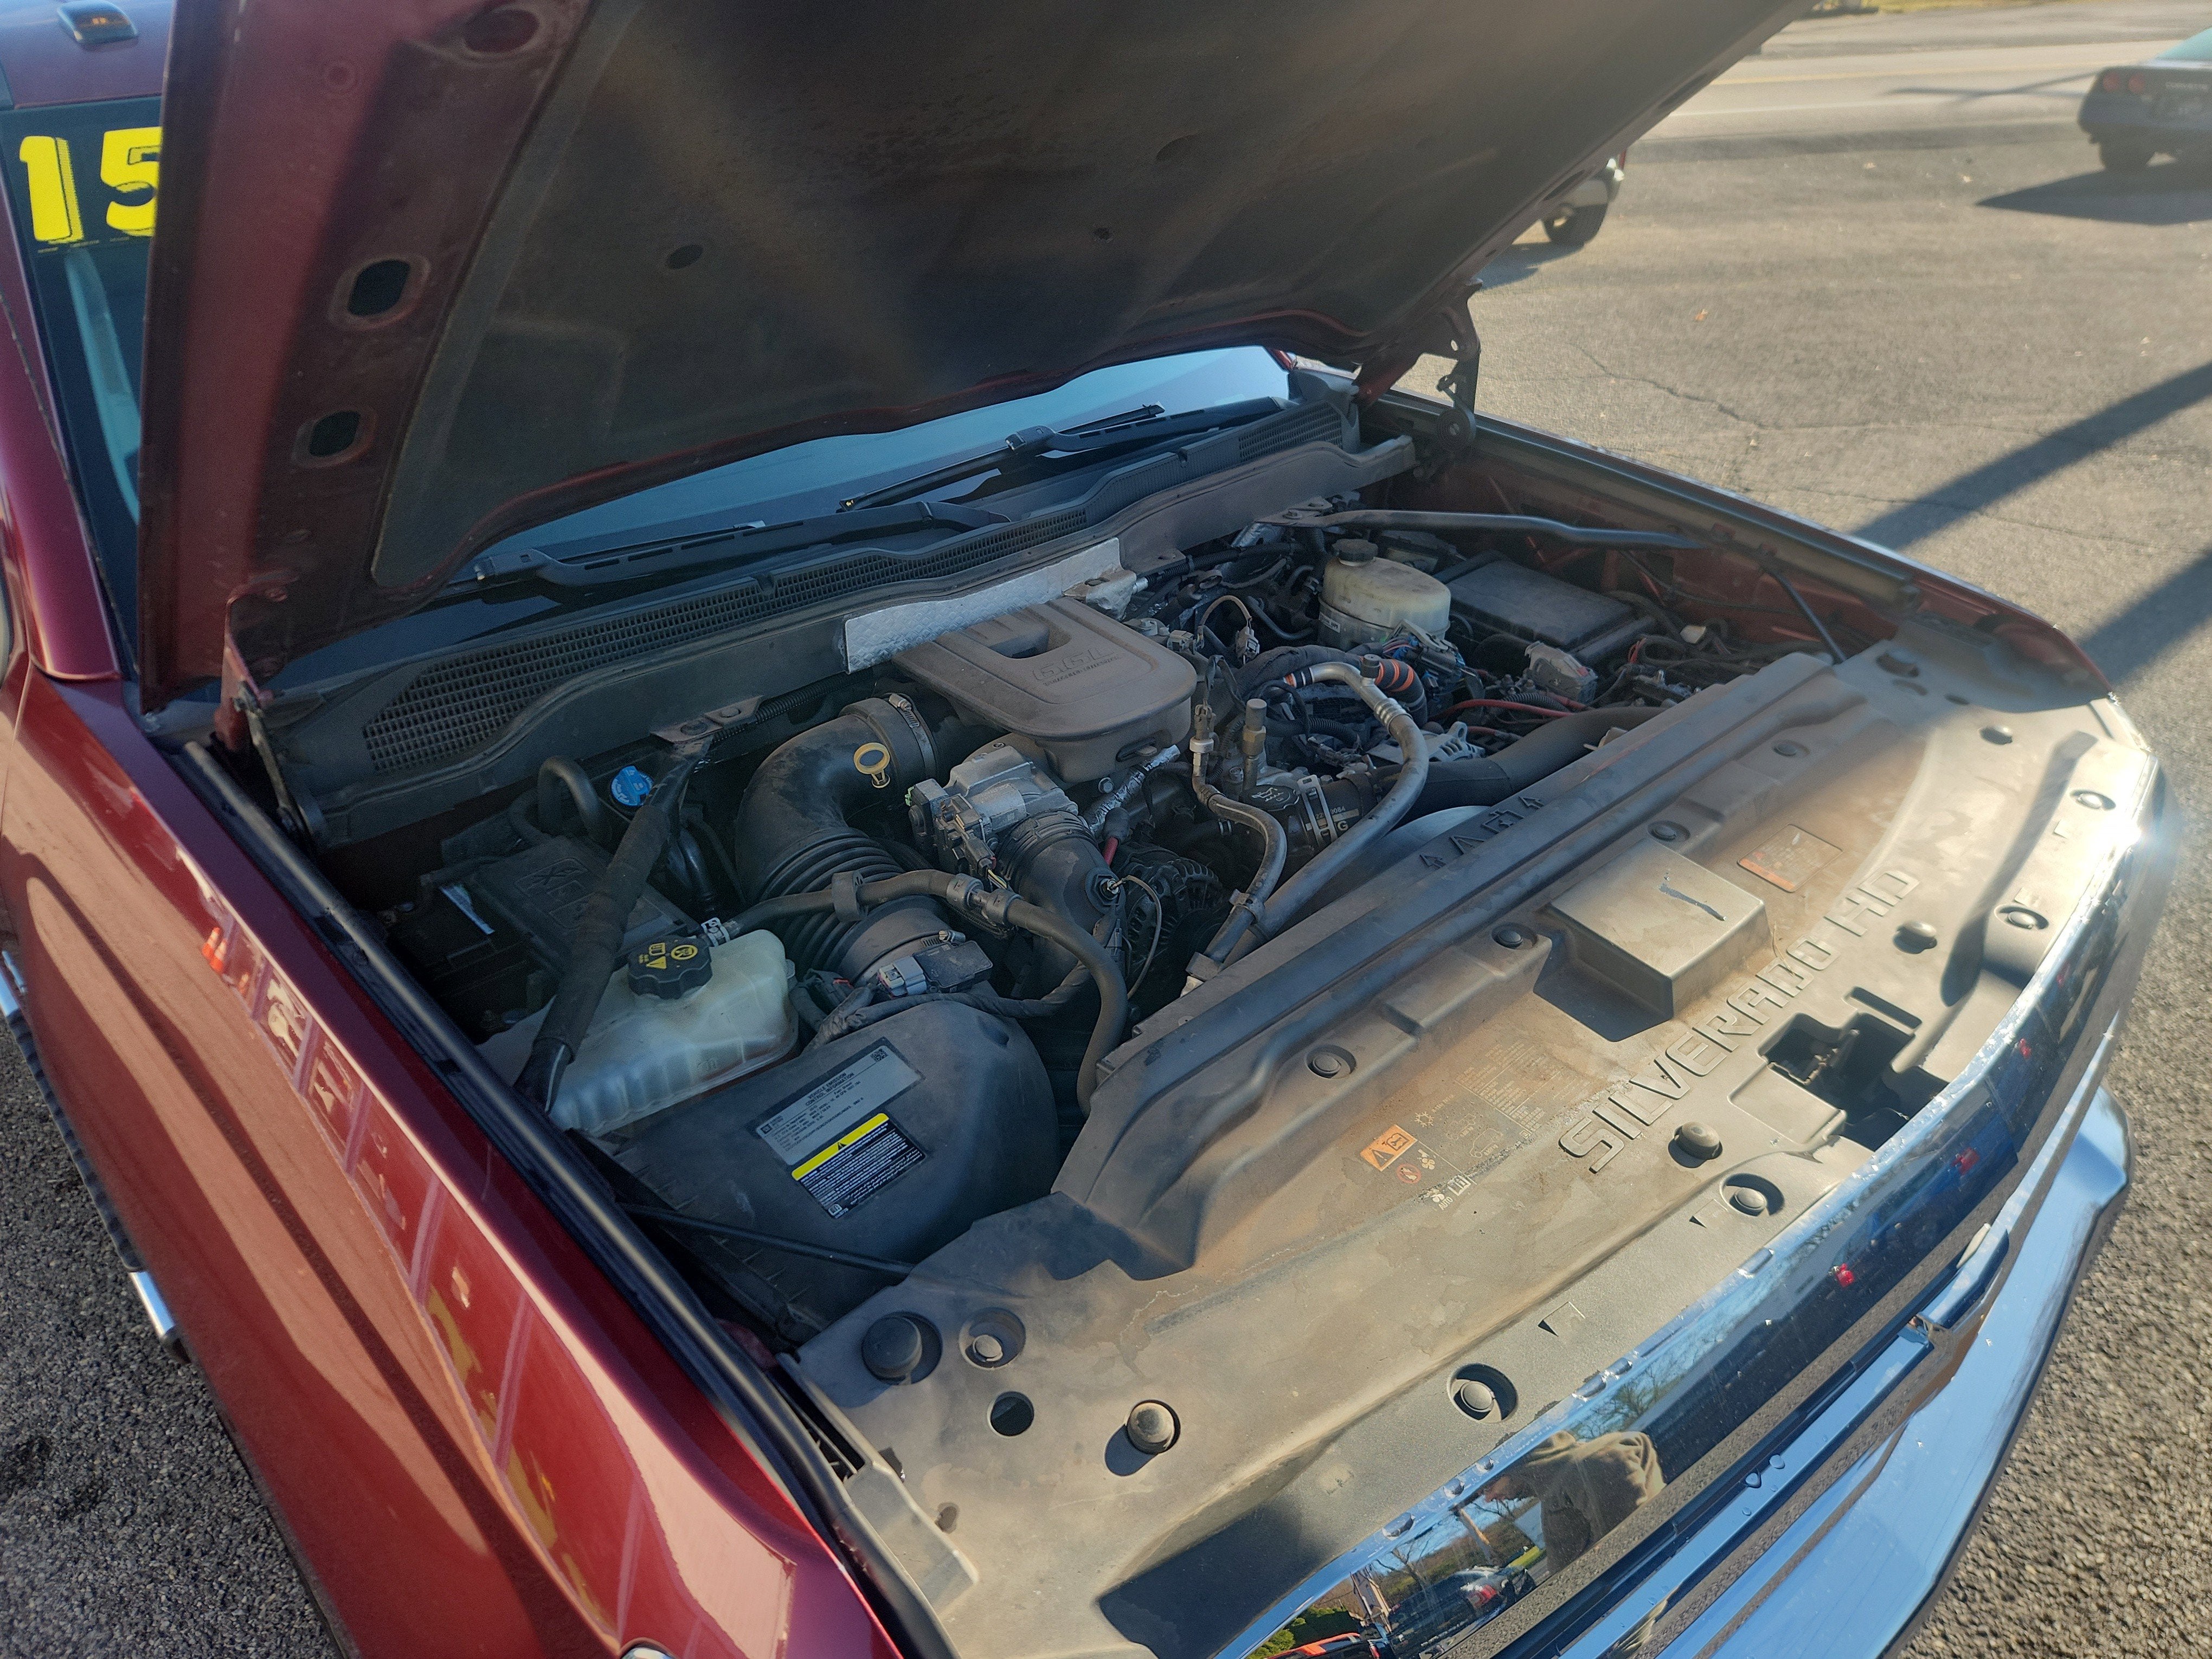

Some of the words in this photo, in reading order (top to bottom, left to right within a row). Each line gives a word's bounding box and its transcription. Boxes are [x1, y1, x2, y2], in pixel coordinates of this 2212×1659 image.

[19, 126, 162, 243] 15
[1558, 938, 1841, 1174] SILVERADO
[1823, 870, 1920, 937] HD
[805, 1091, 826, 1106] CONTROL
[825, 1072, 855, 1093] INFORMATION
[826, 1072, 847, 1087] EMISSION
[1438, 1196, 1454, 1211] AUTO
